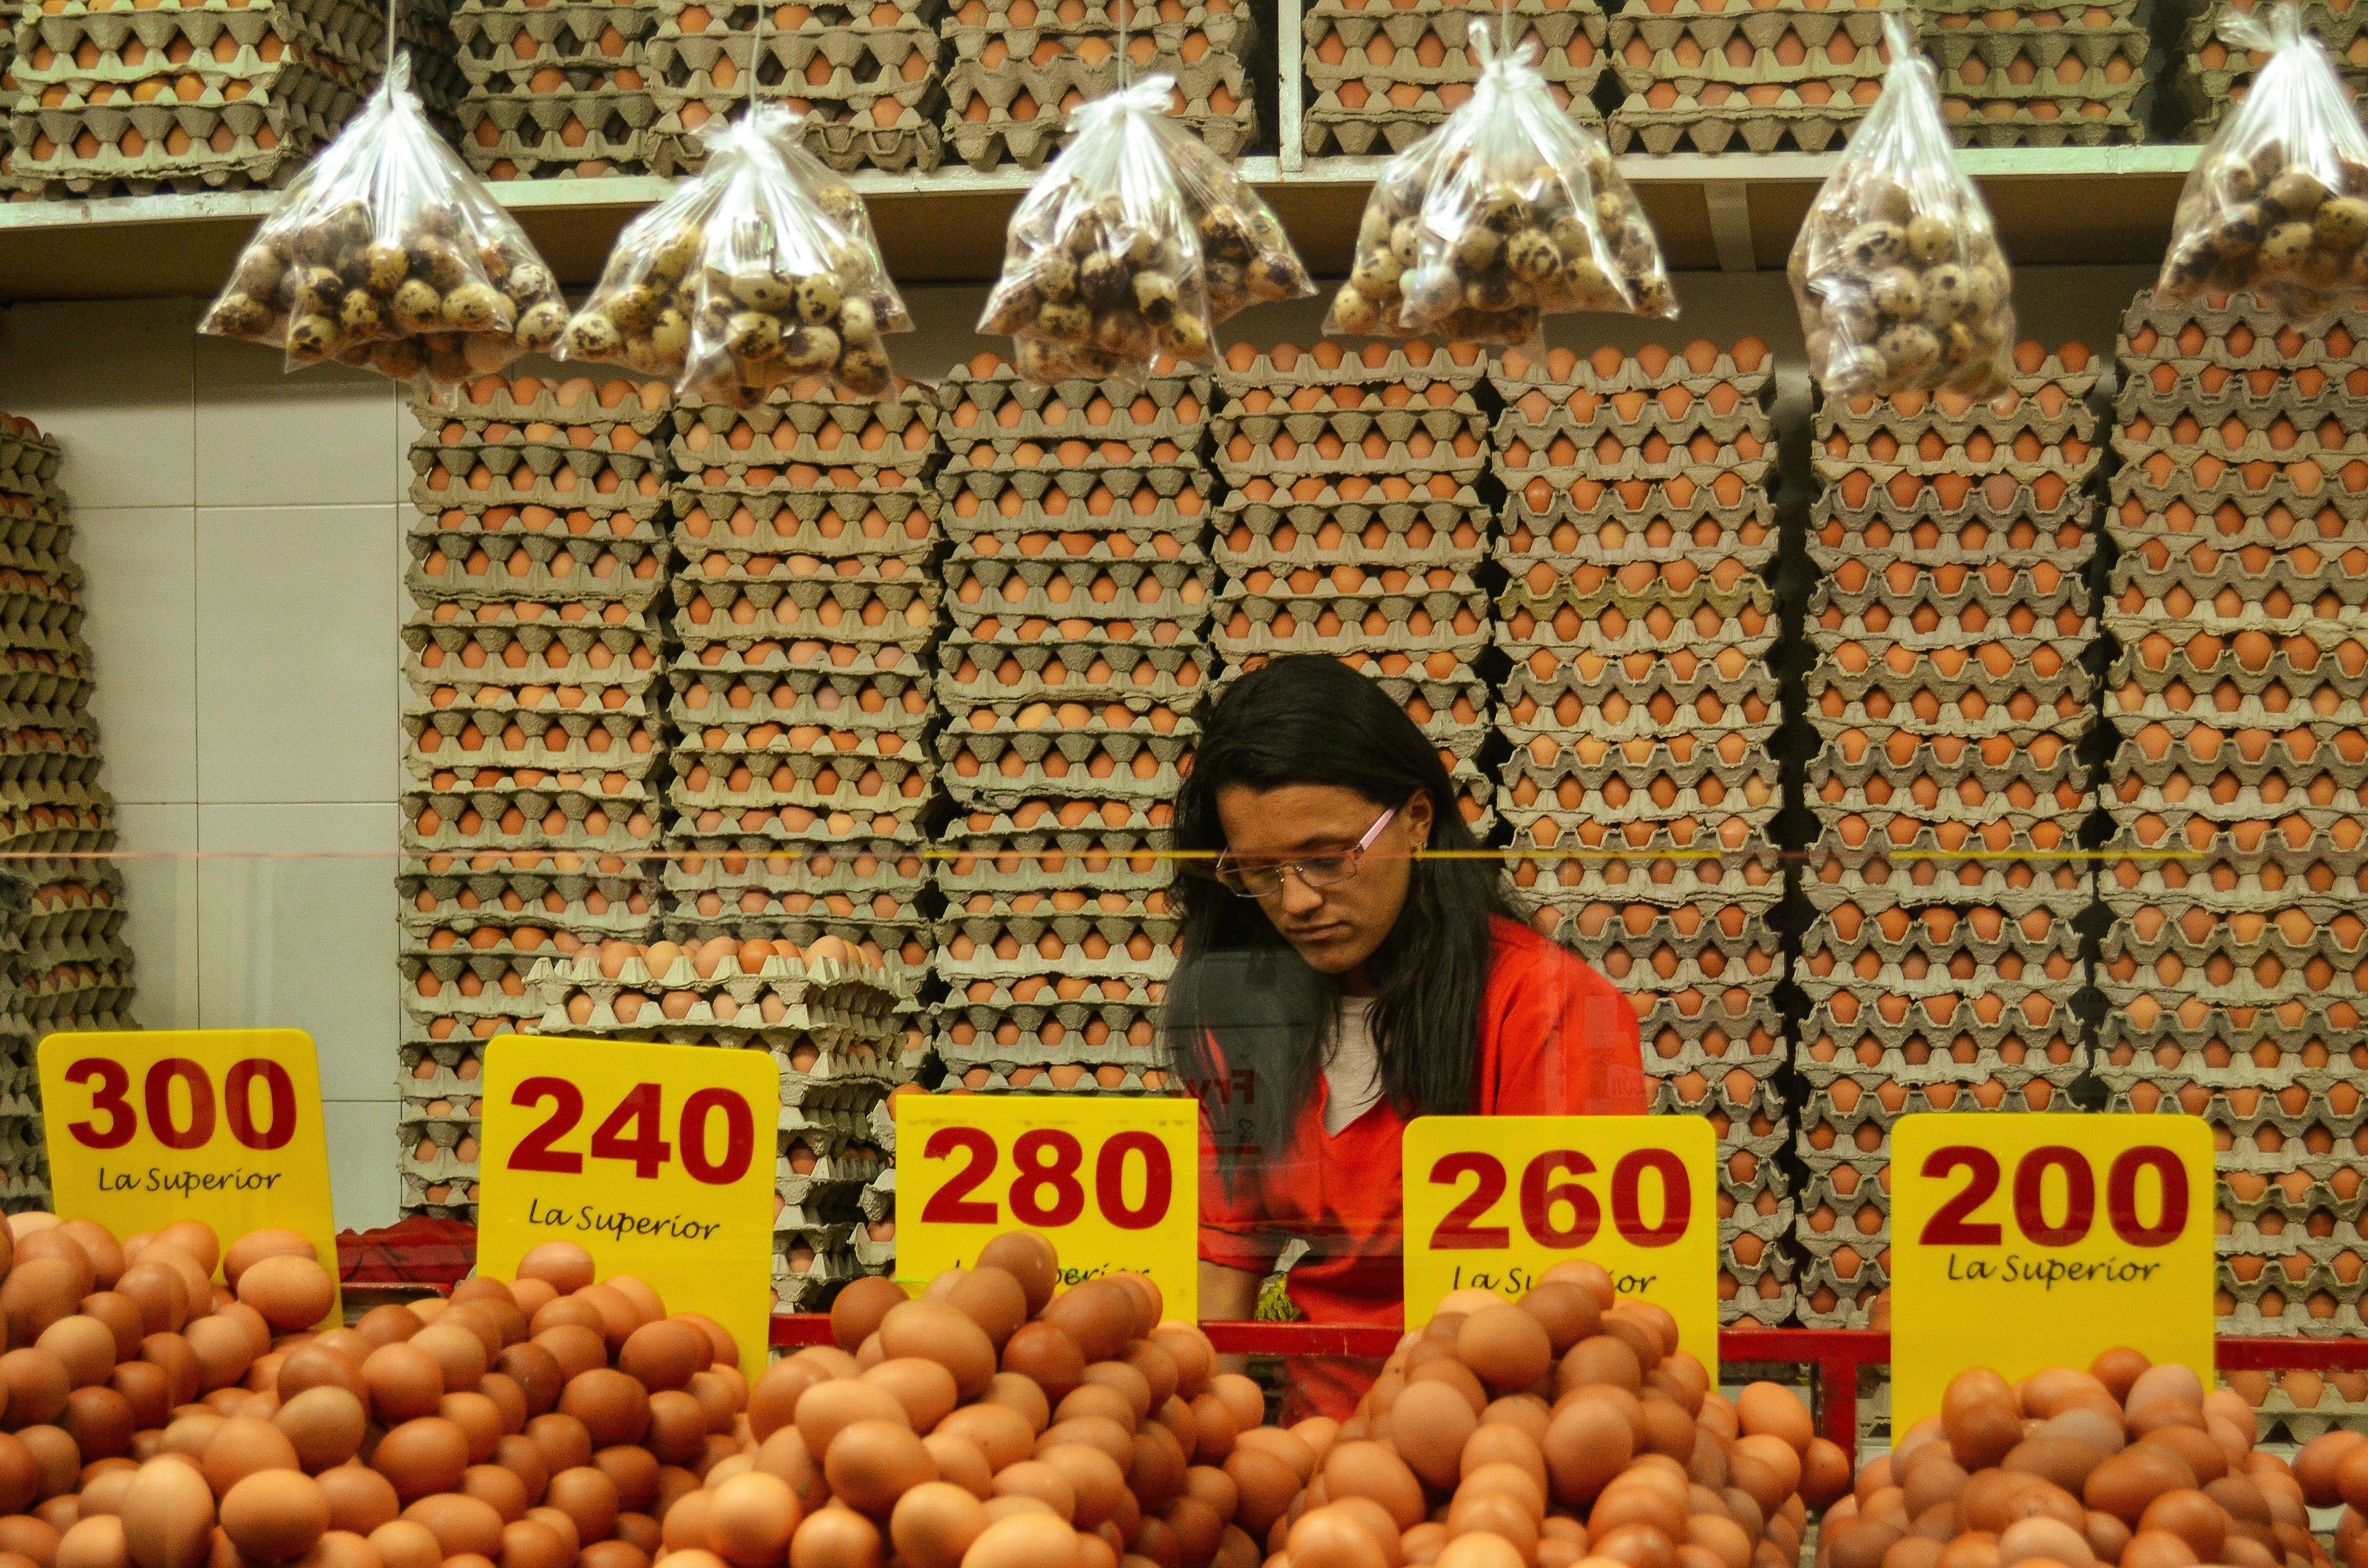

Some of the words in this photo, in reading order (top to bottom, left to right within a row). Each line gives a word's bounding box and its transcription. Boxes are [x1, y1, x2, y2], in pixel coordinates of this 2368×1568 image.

[64, 1057, 297, 1150] 300
[507, 1076, 754, 1185] 240
[99, 1168, 141, 1191] La
[147, 1168, 282, 1198] Superior
[530, 1199, 572, 1225] La
[577, 1206, 720, 1241] Superior
[921, 1127, 1172, 1230] 280
[1429, 1148, 1691, 1249] 260
[1919, 1145, 2189, 1248] 200
[1949, 1254, 1995, 1280] La
[2002, 1256, 2159, 1290] Superior
